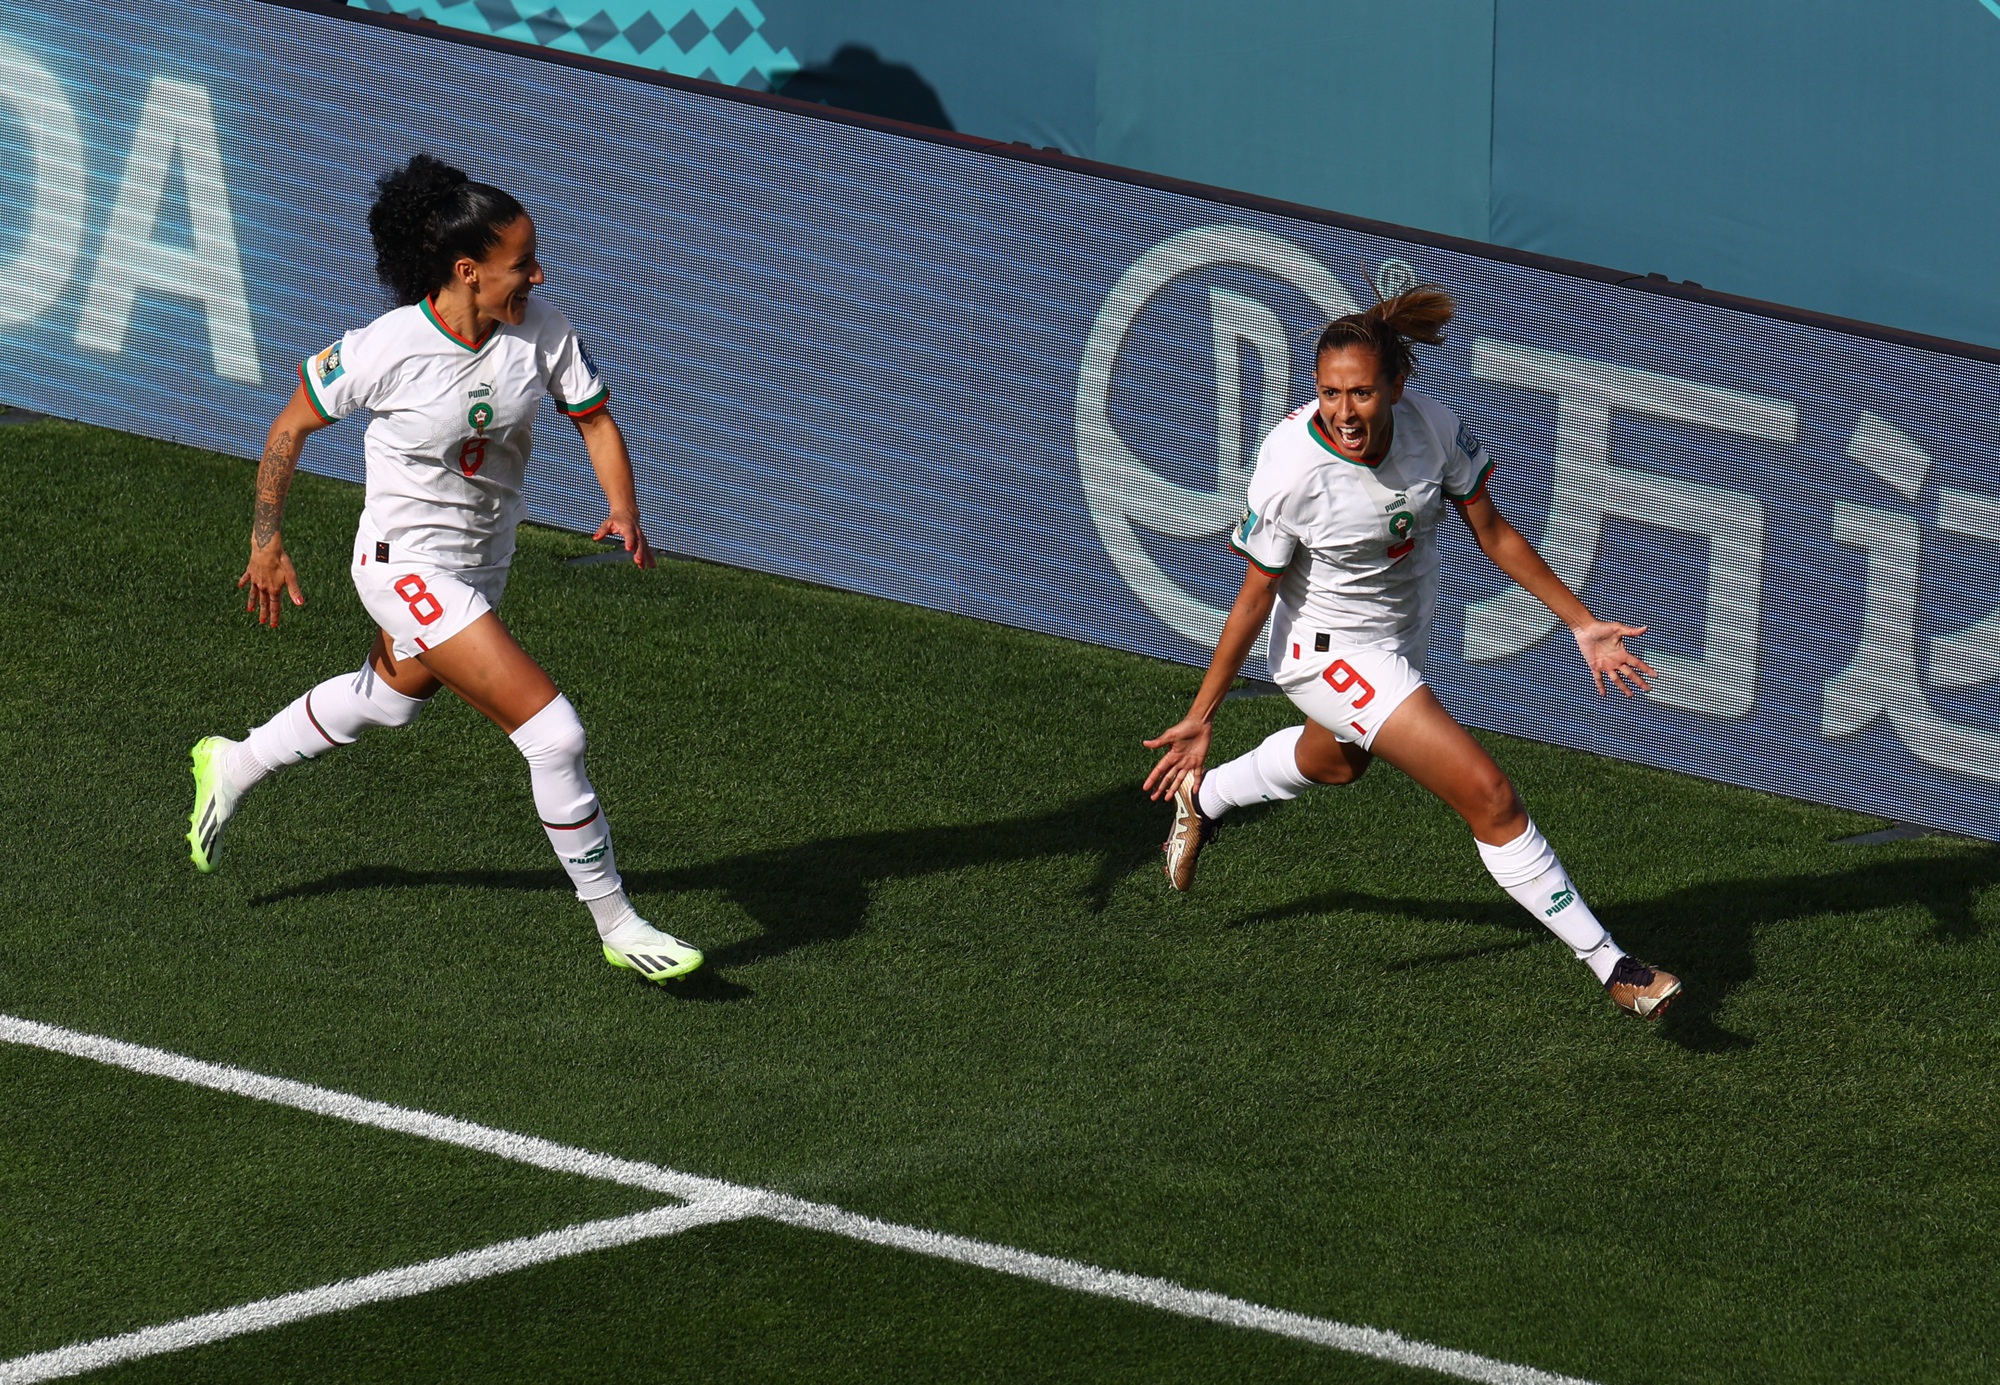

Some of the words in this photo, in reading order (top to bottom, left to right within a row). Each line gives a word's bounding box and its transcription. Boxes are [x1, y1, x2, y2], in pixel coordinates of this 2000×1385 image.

[468, 388, 490, 399] PUMA
[1385, 497, 1407, 513] PUMA
[394, 574, 444, 626] 8
[1322, 658, 1376, 710] 9
[1544, 892, 1575, 918] PUMA
